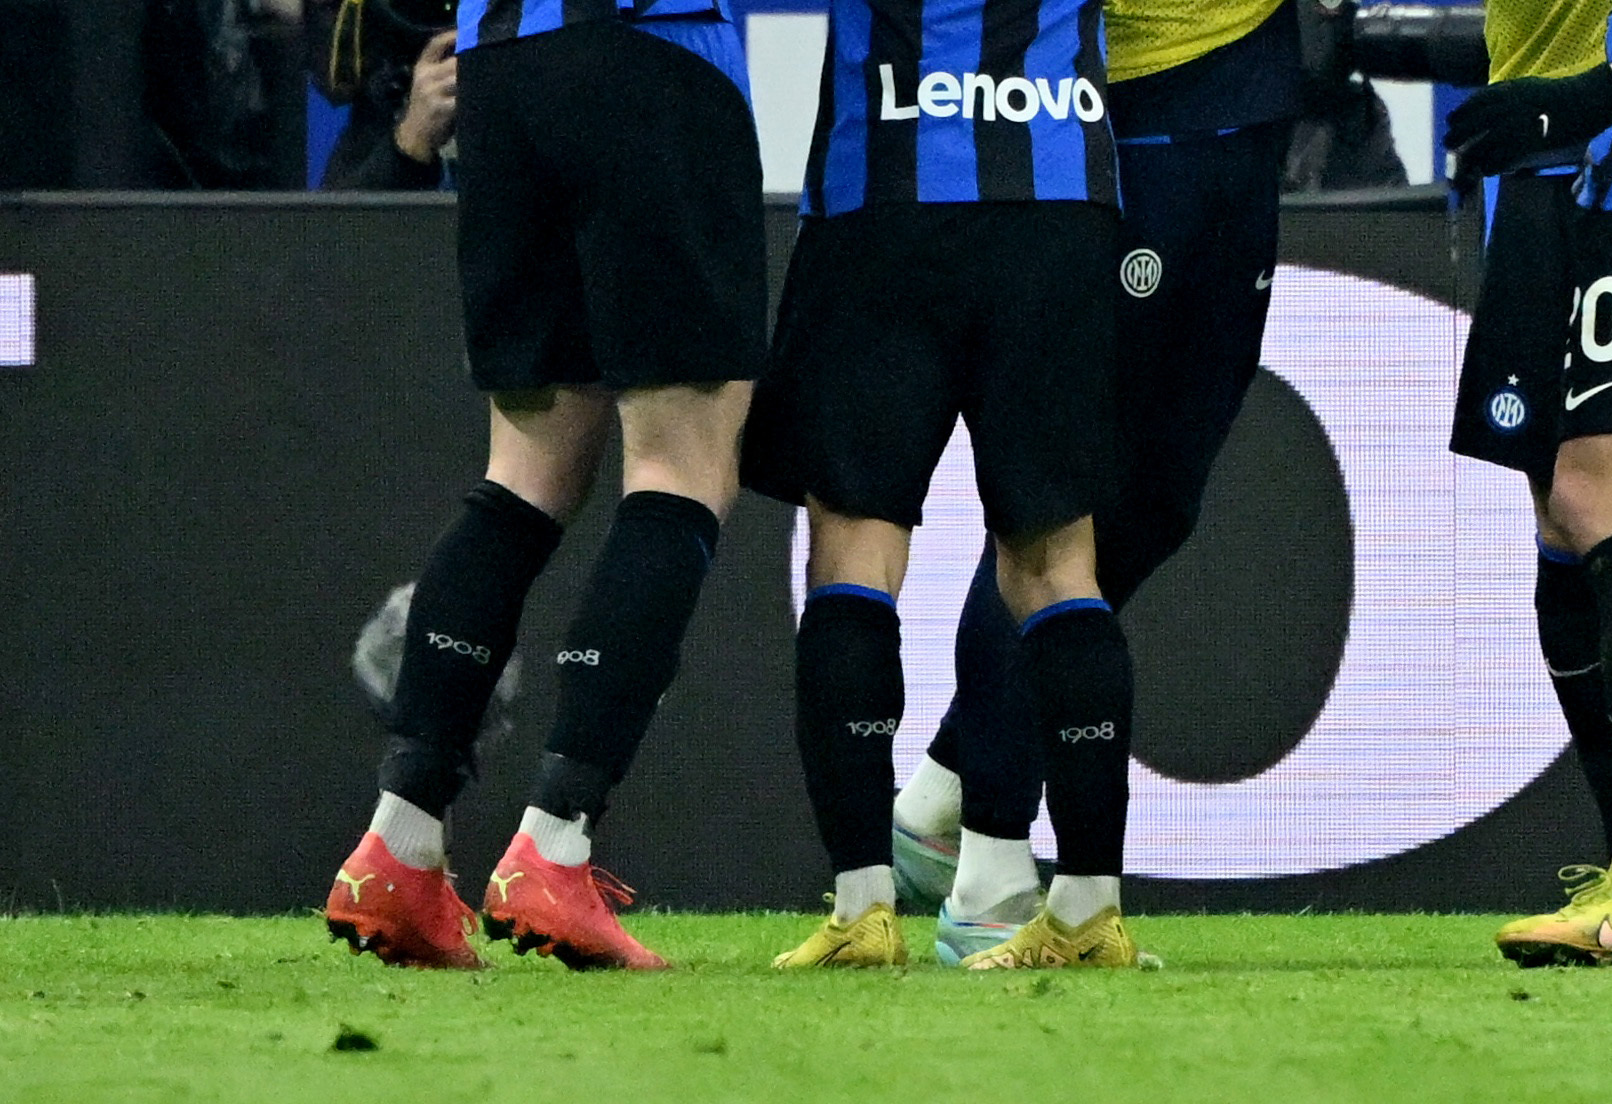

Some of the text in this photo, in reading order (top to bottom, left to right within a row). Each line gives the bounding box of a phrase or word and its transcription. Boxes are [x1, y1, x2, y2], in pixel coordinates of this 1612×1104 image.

[879, 63, 1106, 123] Lenovo
[426, 632, 491, 665] 1908
[847, 718, 896, 737] 1908
[1059, 721, 1115, 744] 1908
